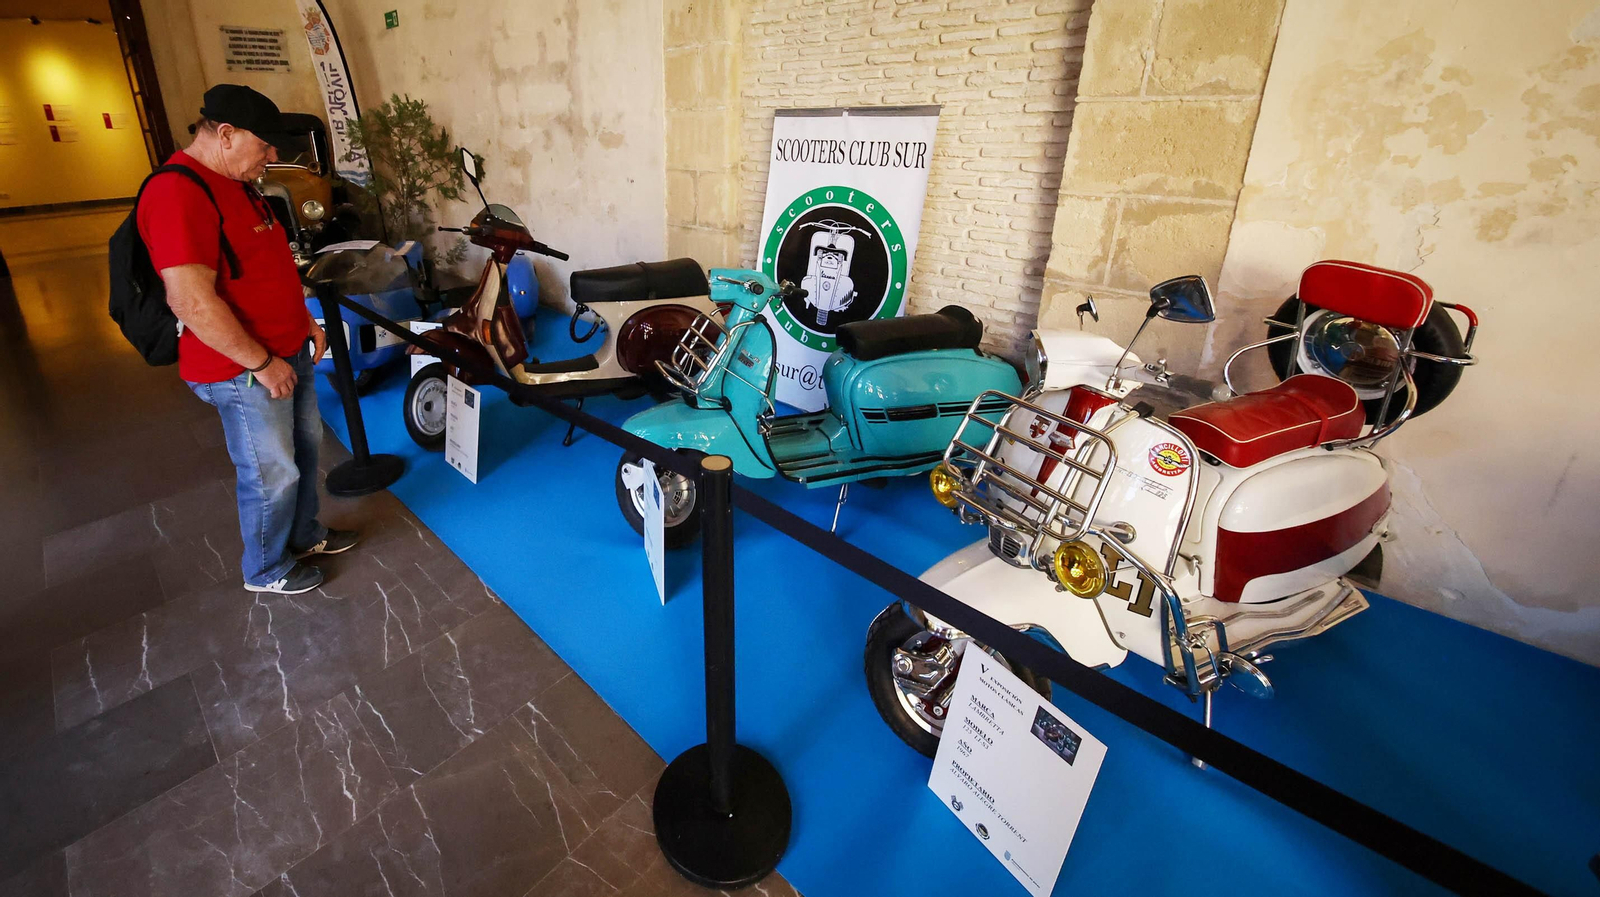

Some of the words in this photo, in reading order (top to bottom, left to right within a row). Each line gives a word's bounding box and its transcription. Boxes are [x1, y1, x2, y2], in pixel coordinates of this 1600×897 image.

[775, 138, 846, 165] SCOOTERS
[850, 140, 891, 167] CLUB
[893, 141, 927, 169] SUR
[776, 189, 902, 253] scooters
[1151, 457, 1182, 475] LAMBRETTA
[981, 663, 989, 674] V
[979, 677, 997, 694] MOTOS
[968, 702, 1005, 736] LAMBRETTA
[971, 694, 995, 719] MARCA
[964, 716, 993, 745] MODELO
[951, 760, 995, 804] PROPIETARIO
[950, 767, 973, 790] ALVARO
[973, 791, 997, 815] ALEGRE
[997, 813, 1028, 843] TORRENT
